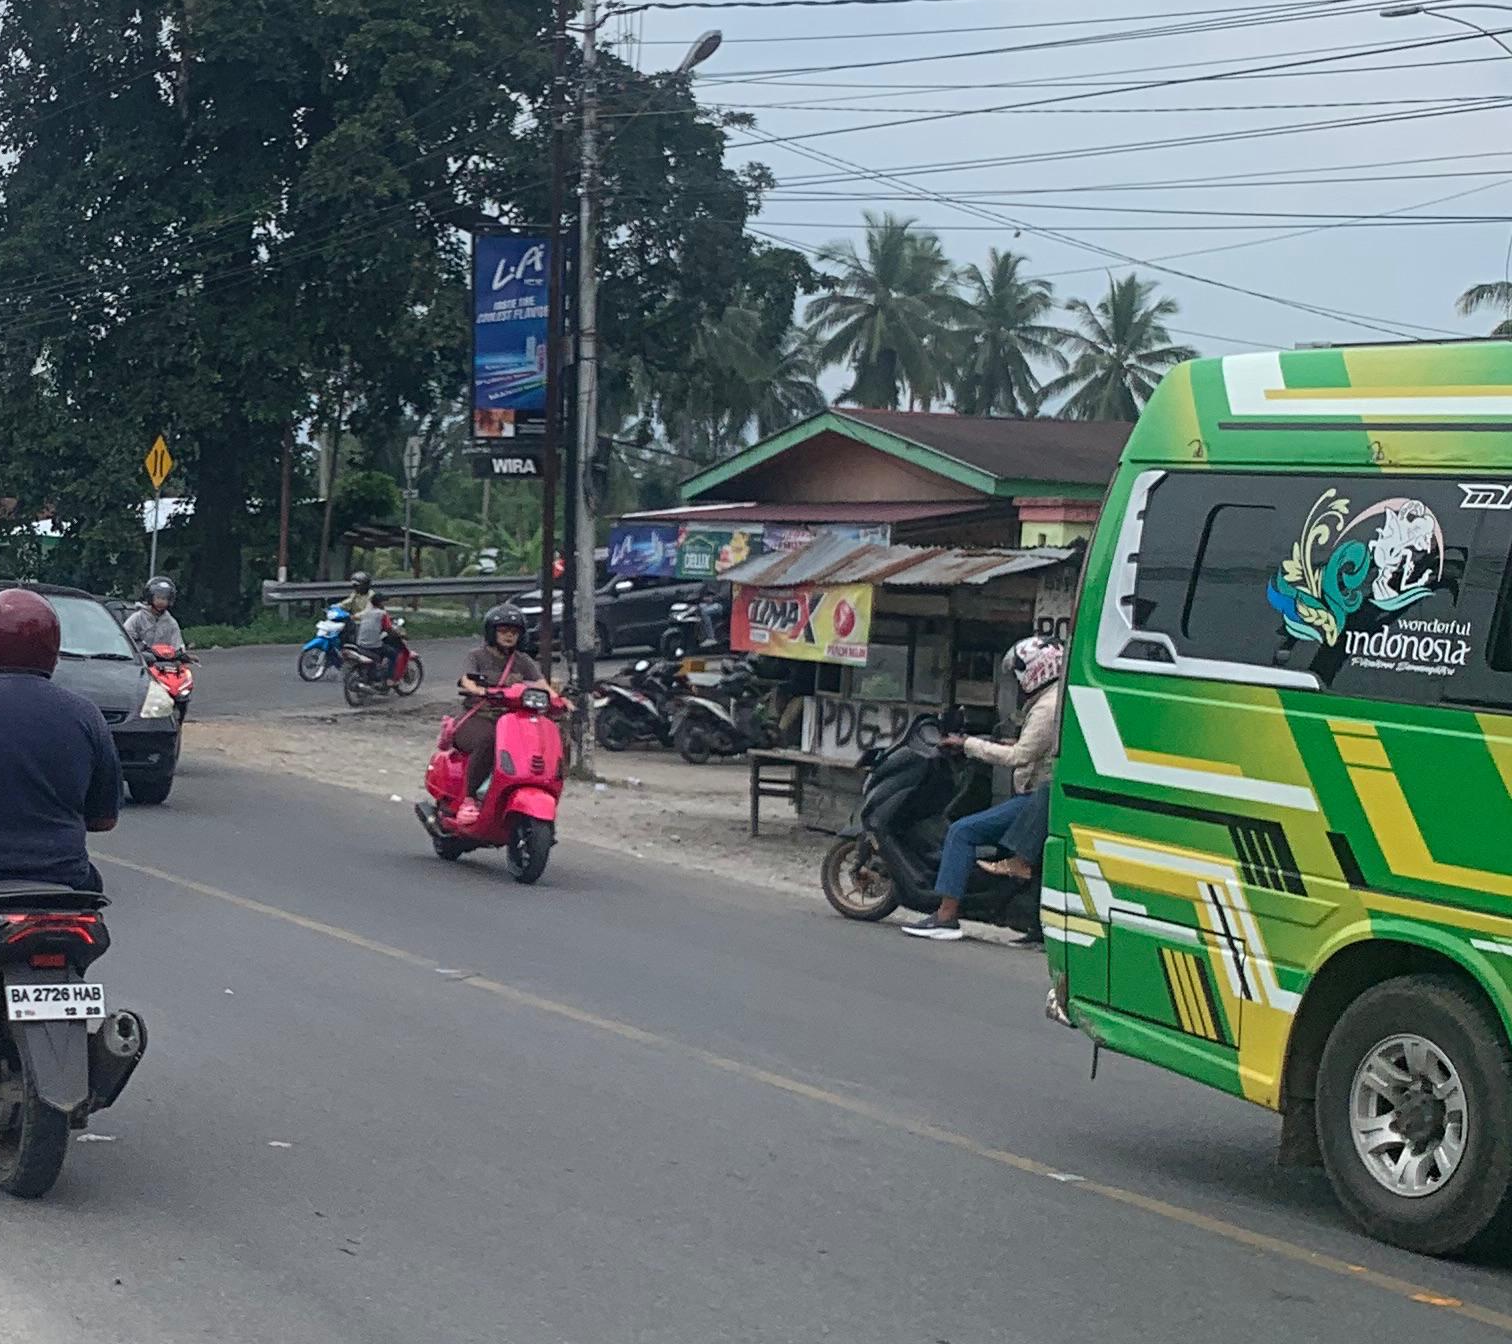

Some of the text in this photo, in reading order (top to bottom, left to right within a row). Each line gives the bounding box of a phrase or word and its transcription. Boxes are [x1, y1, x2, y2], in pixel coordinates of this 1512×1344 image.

[491, 458, 537, 474] WIRA
[1398, 617, 1472, 638] wonderful
[1345, 623, 1472, 666] indonesia
[11, 986, 101, 1003] BA 2726 HAB
